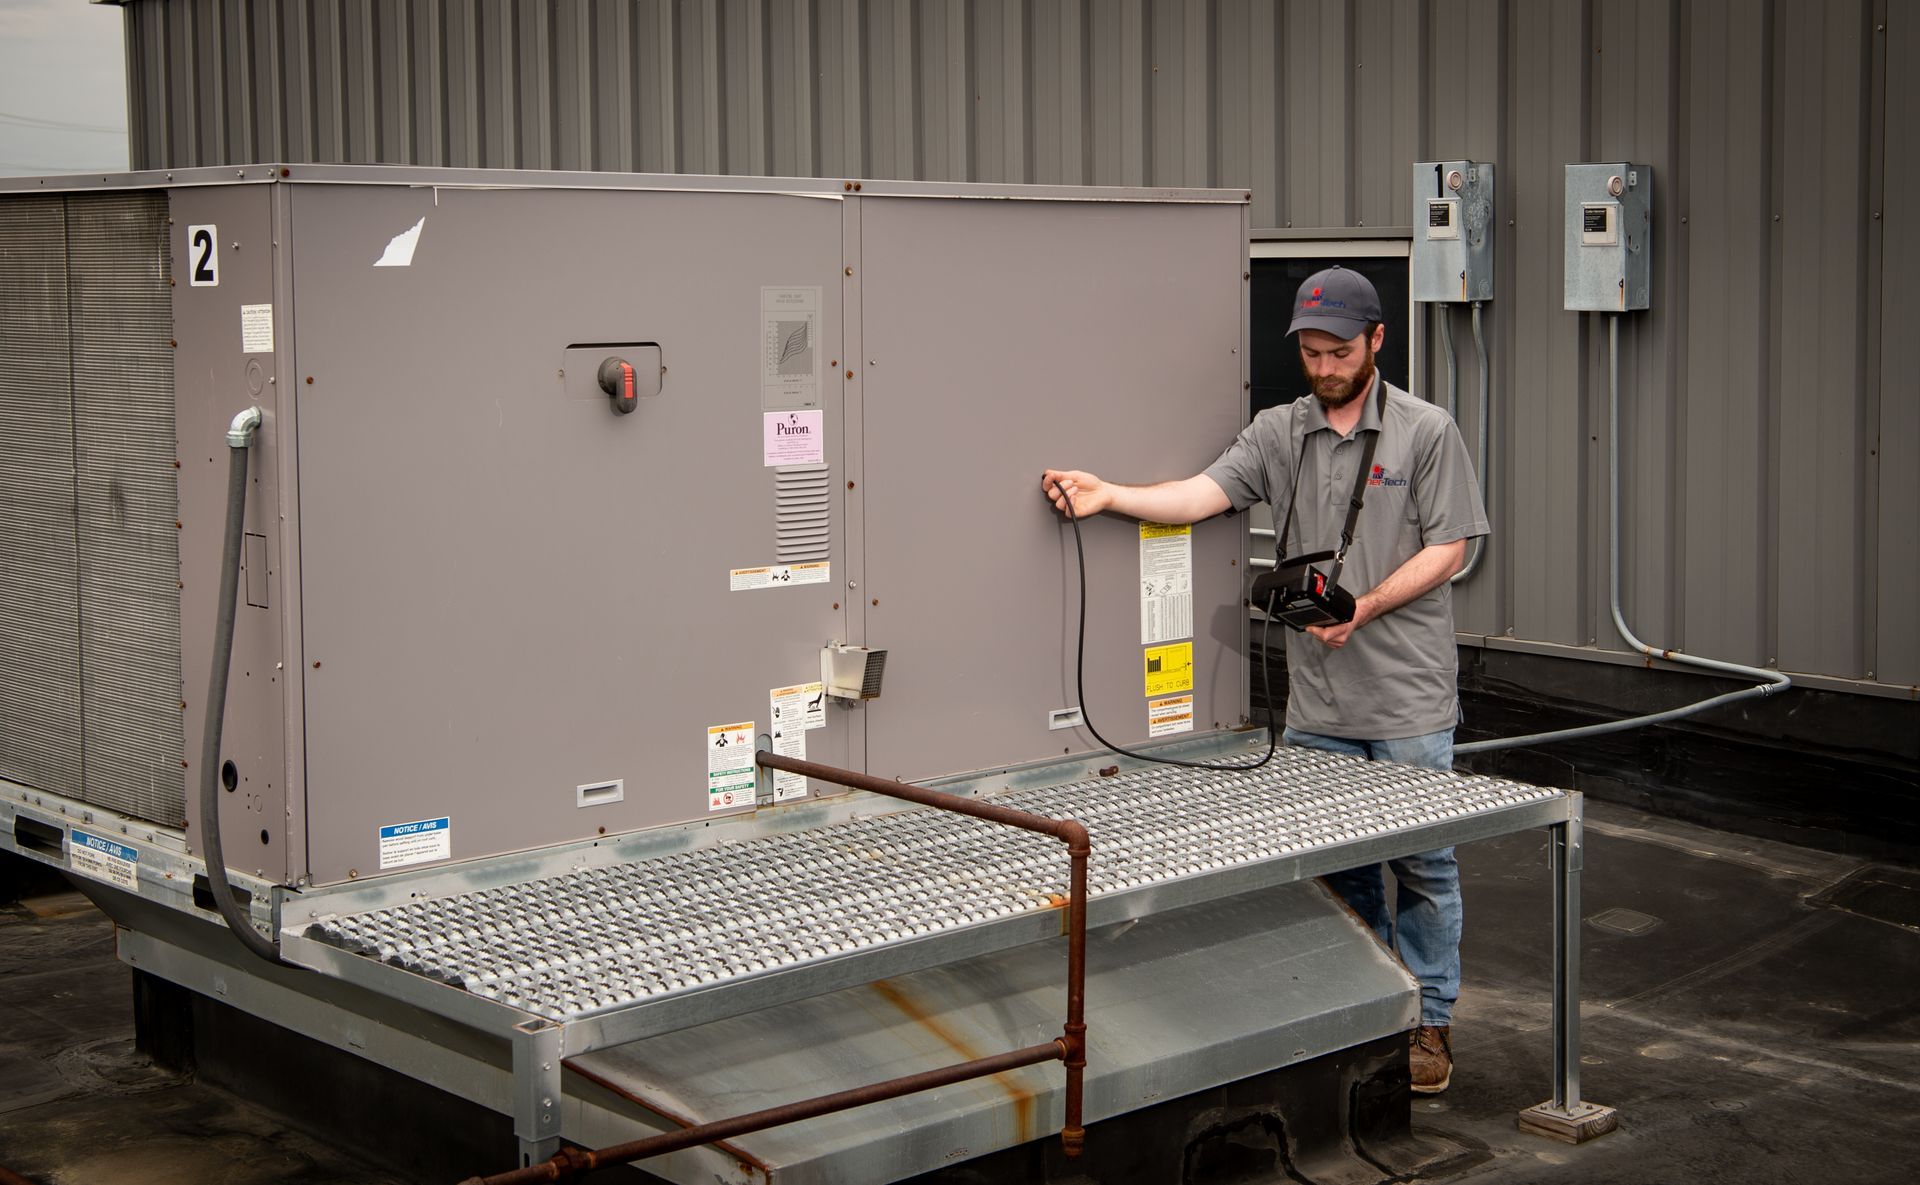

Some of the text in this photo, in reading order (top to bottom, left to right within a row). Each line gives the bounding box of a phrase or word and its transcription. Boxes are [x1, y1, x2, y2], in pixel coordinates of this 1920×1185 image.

[1435, 164, 1444, 198] 1
[193, 229, 214, 282] 2
[1365, 477, 1408, 487] ner-Tech
[1176, 679, 1189, 687] CURB
[394, 825, 418, 834] NOTICE
[422, 821, 437, 831] AVIS
[87, 837, 106, 850] NOTICE
[109, 844, 122, 856] AVIS
